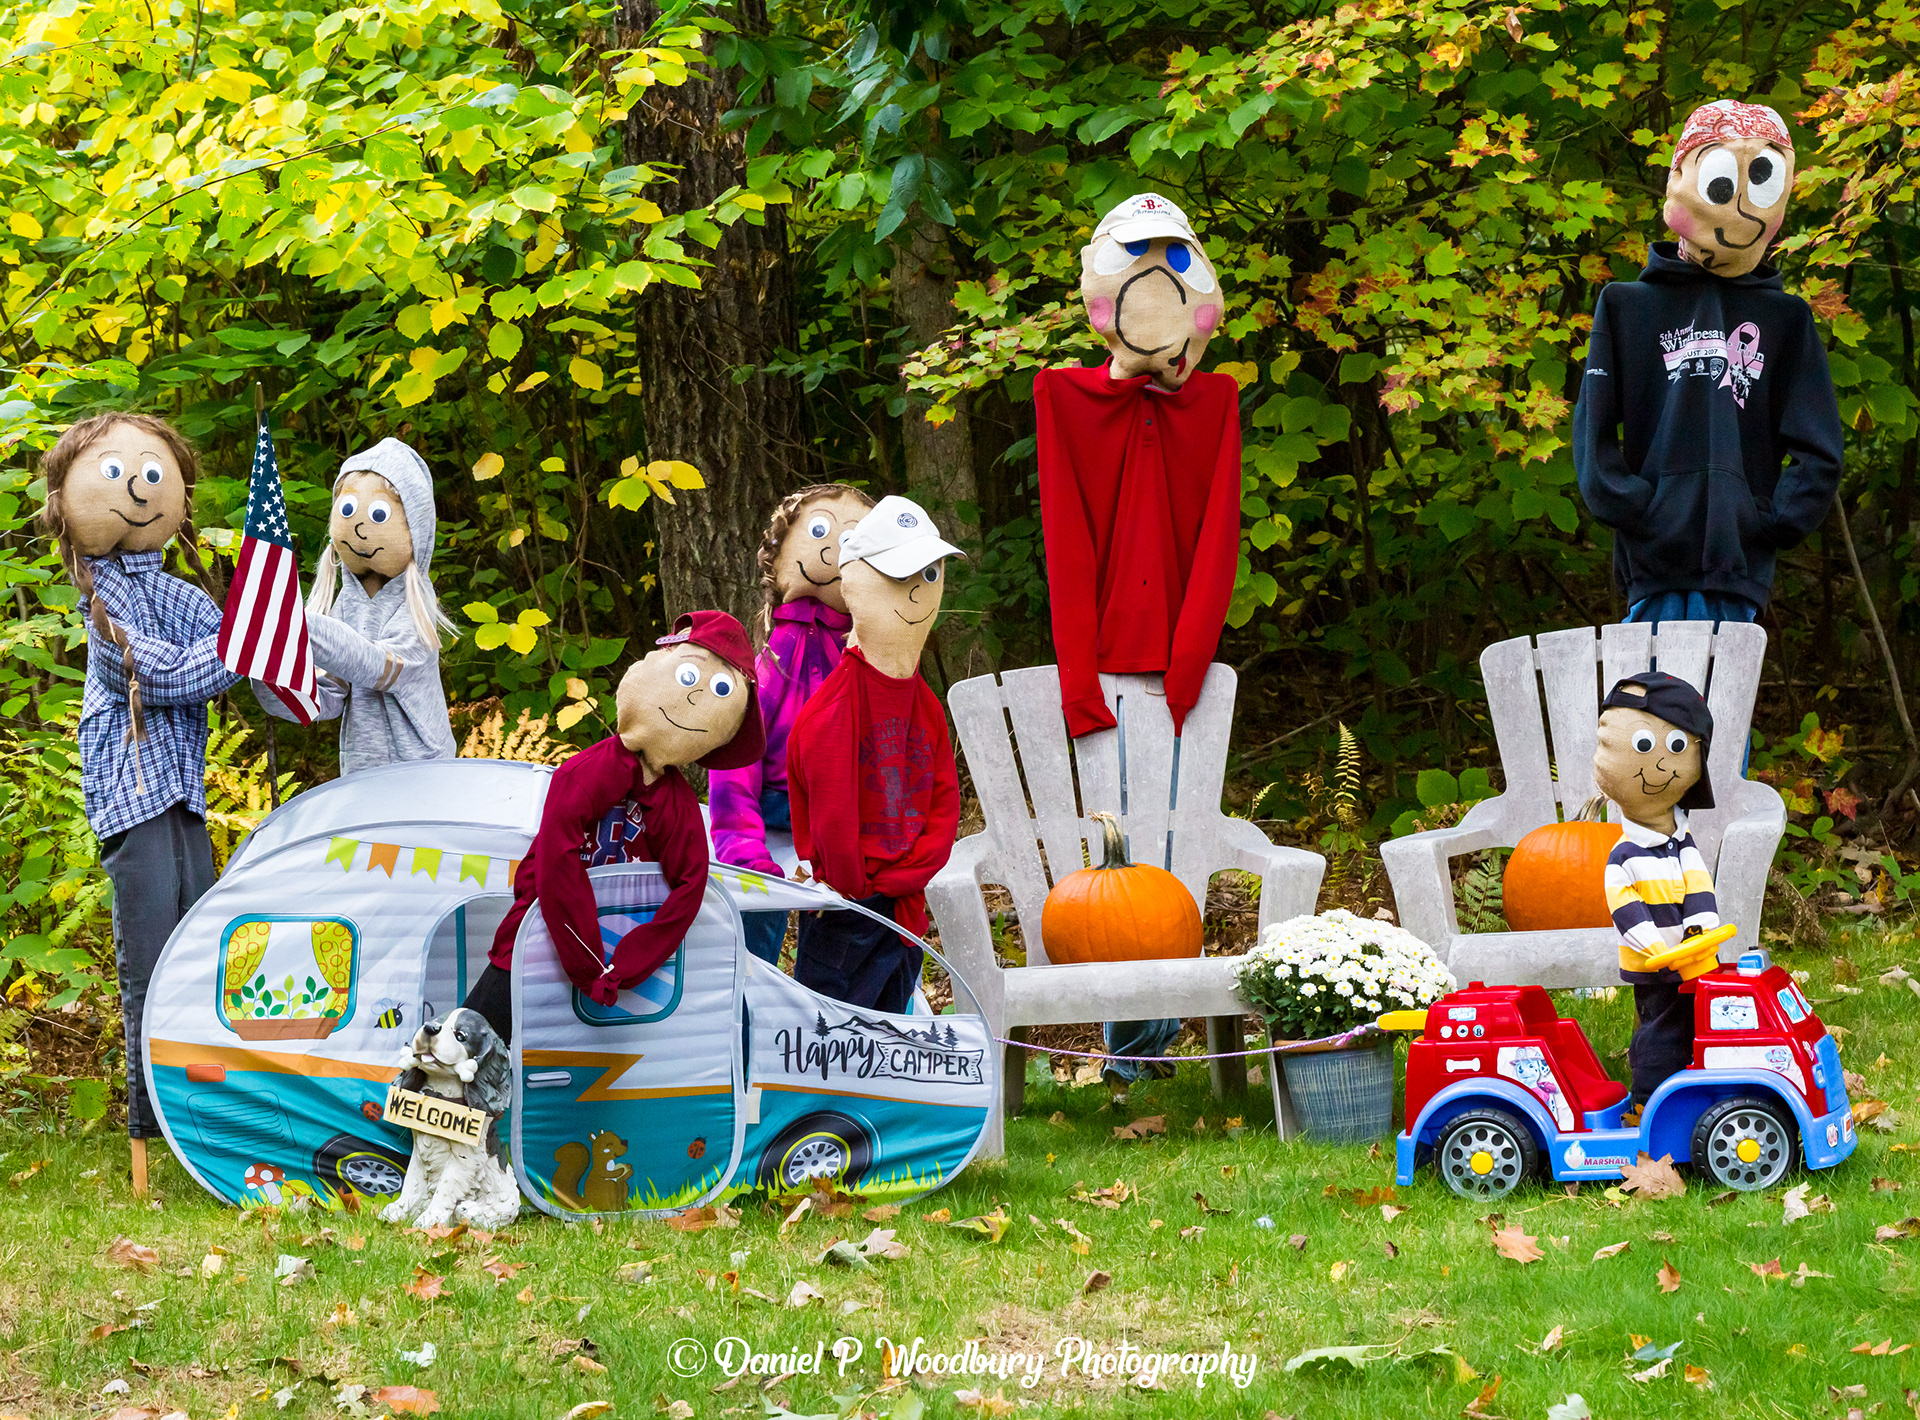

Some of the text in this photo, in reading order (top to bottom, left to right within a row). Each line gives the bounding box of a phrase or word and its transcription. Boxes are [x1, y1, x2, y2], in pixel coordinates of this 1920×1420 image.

[1145, 199, 1156, 210] B
[1660, 330, 1673, 343] 5th
[775, 1026, 970, 1081] Happy CAMPER
[389, 1092, 481, 1137] WELCOME
[1584, 1157, 1629, 1166] MARSHALL
